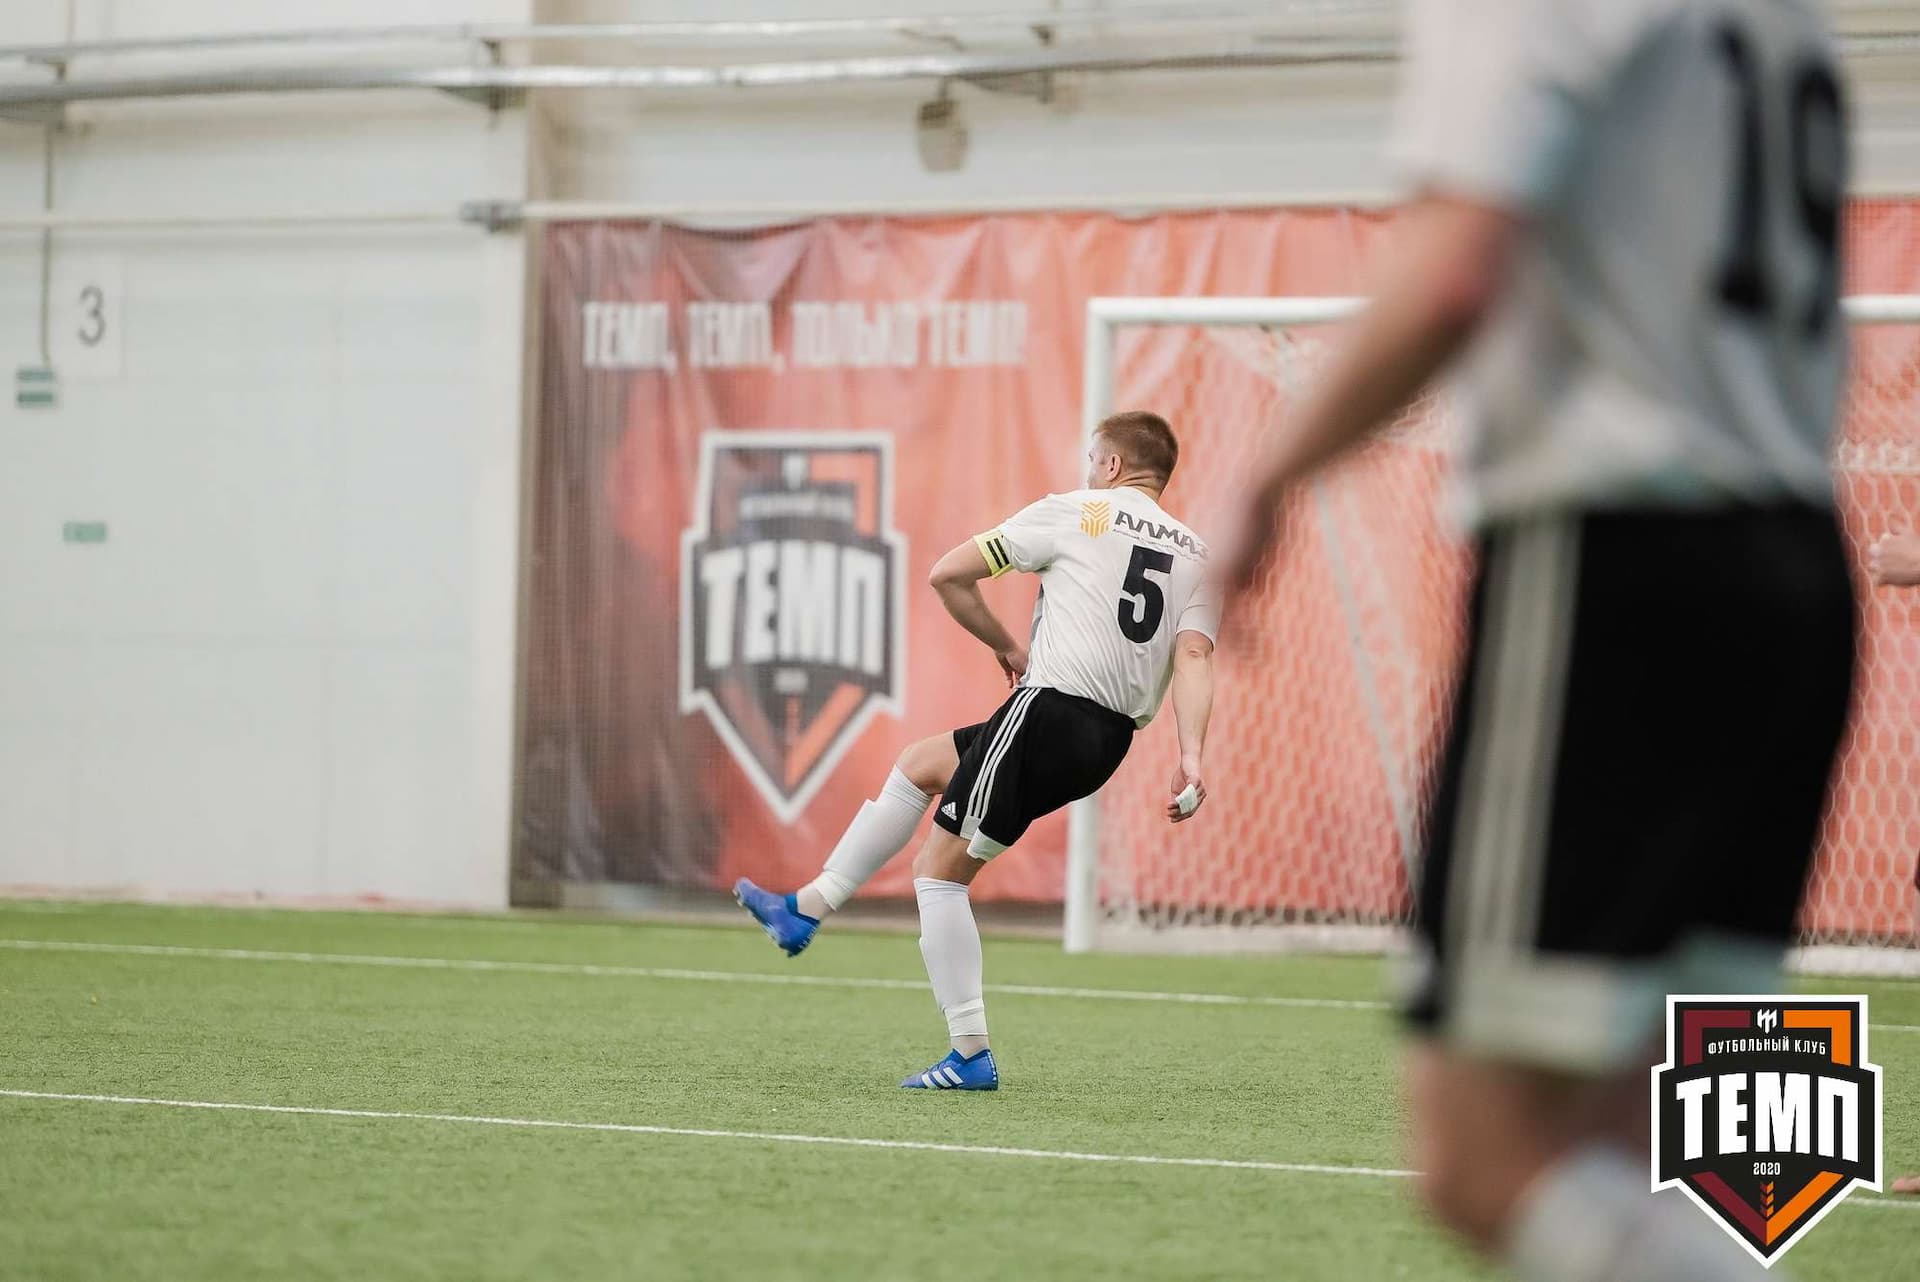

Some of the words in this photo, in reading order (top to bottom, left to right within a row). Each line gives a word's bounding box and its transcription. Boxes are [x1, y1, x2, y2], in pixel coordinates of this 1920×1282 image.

[77, 284, 107, 347] 3
[699, 539, 886, 676] ТЕМП
[1117, 544, 1174, 644] 5
